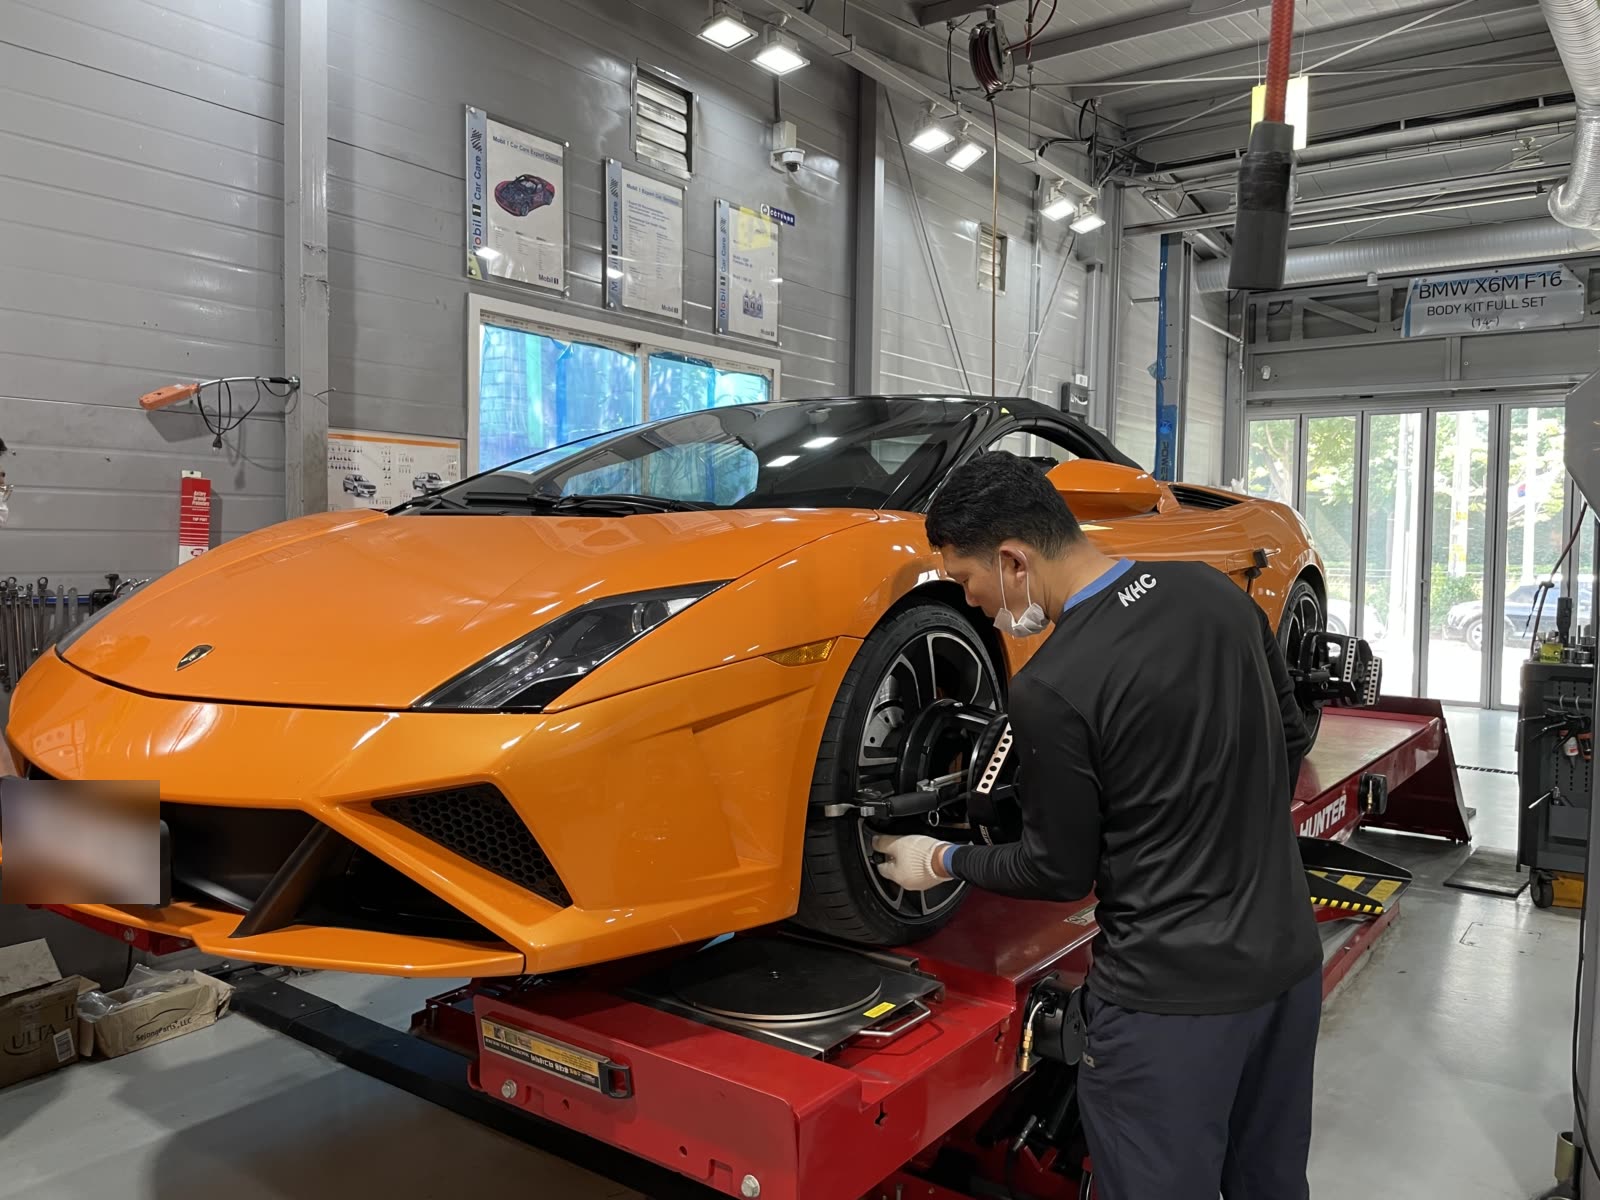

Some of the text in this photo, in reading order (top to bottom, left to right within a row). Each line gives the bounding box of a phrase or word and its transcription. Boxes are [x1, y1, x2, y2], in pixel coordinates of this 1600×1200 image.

[474, 155, 482, 180] Care
[474, 182, 482, 200] Car
[539, 274, 554, 283] Mobil
[1419, 270, 1563, 299] BMW X6M F16
[1427, 296, 1547, 316] BODY KIT FULL SET
[1117, 573, 1157, 607] NHC
[1299, 794, 1347, 838] HUNTER
[180, 1017, 193, 1028] LLC
